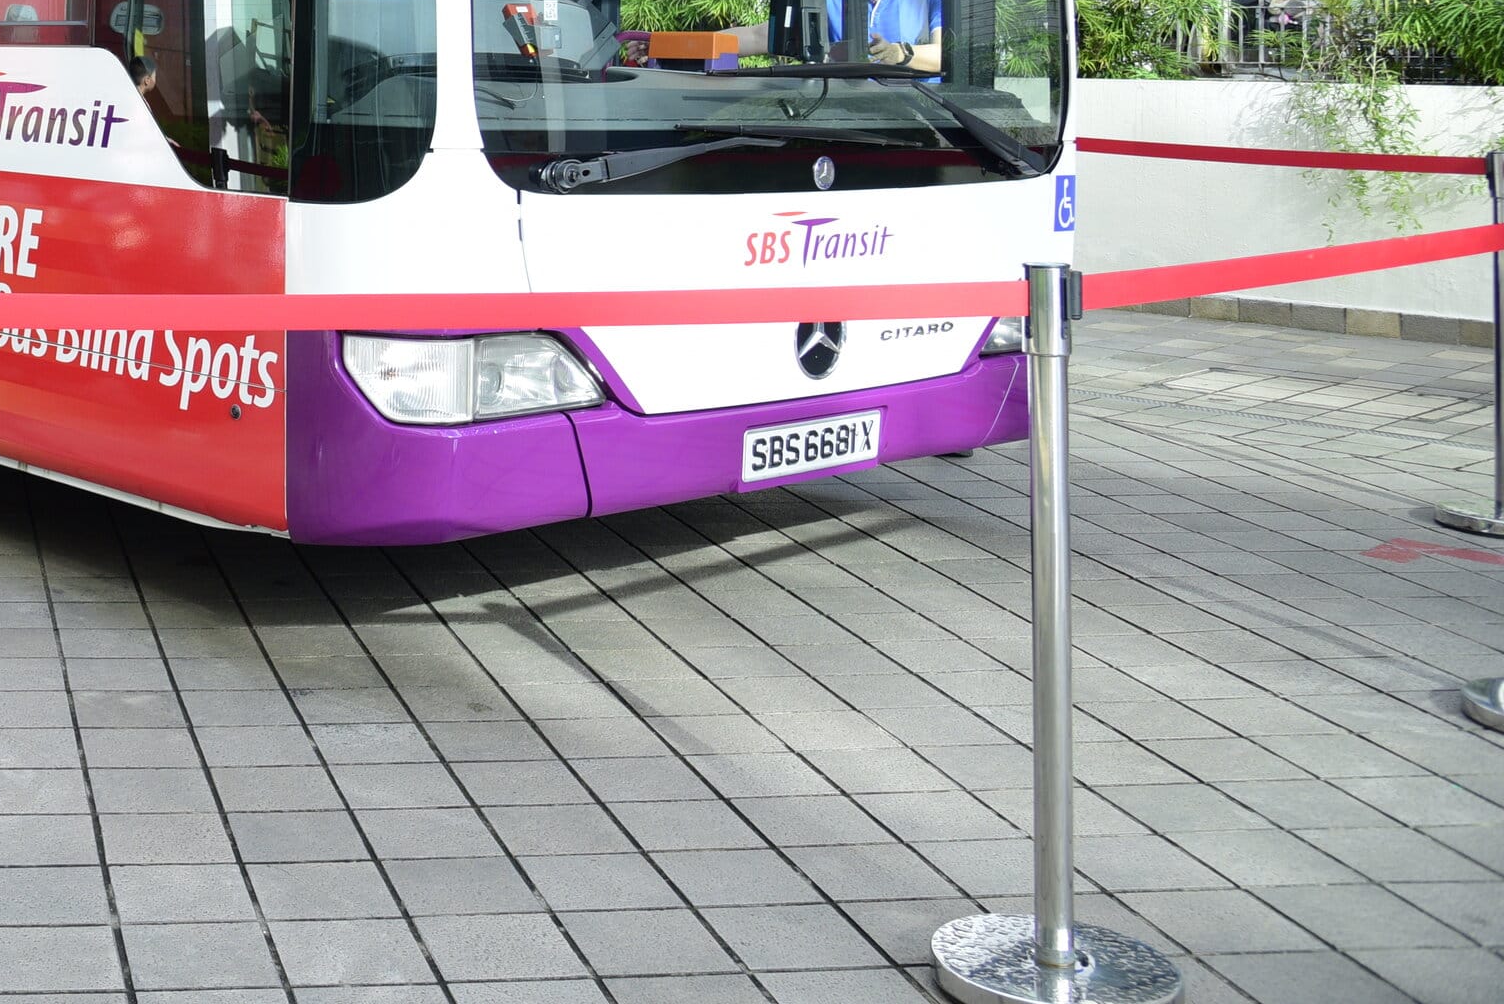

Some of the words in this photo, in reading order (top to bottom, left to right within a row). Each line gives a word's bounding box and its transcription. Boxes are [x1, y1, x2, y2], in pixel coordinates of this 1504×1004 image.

[744, 230, 792, 267] SBS
[791, 217, 896, 269] Transit
[880, 321, 955, 341] CITARO
[158, 328, 279, 411] Spots
